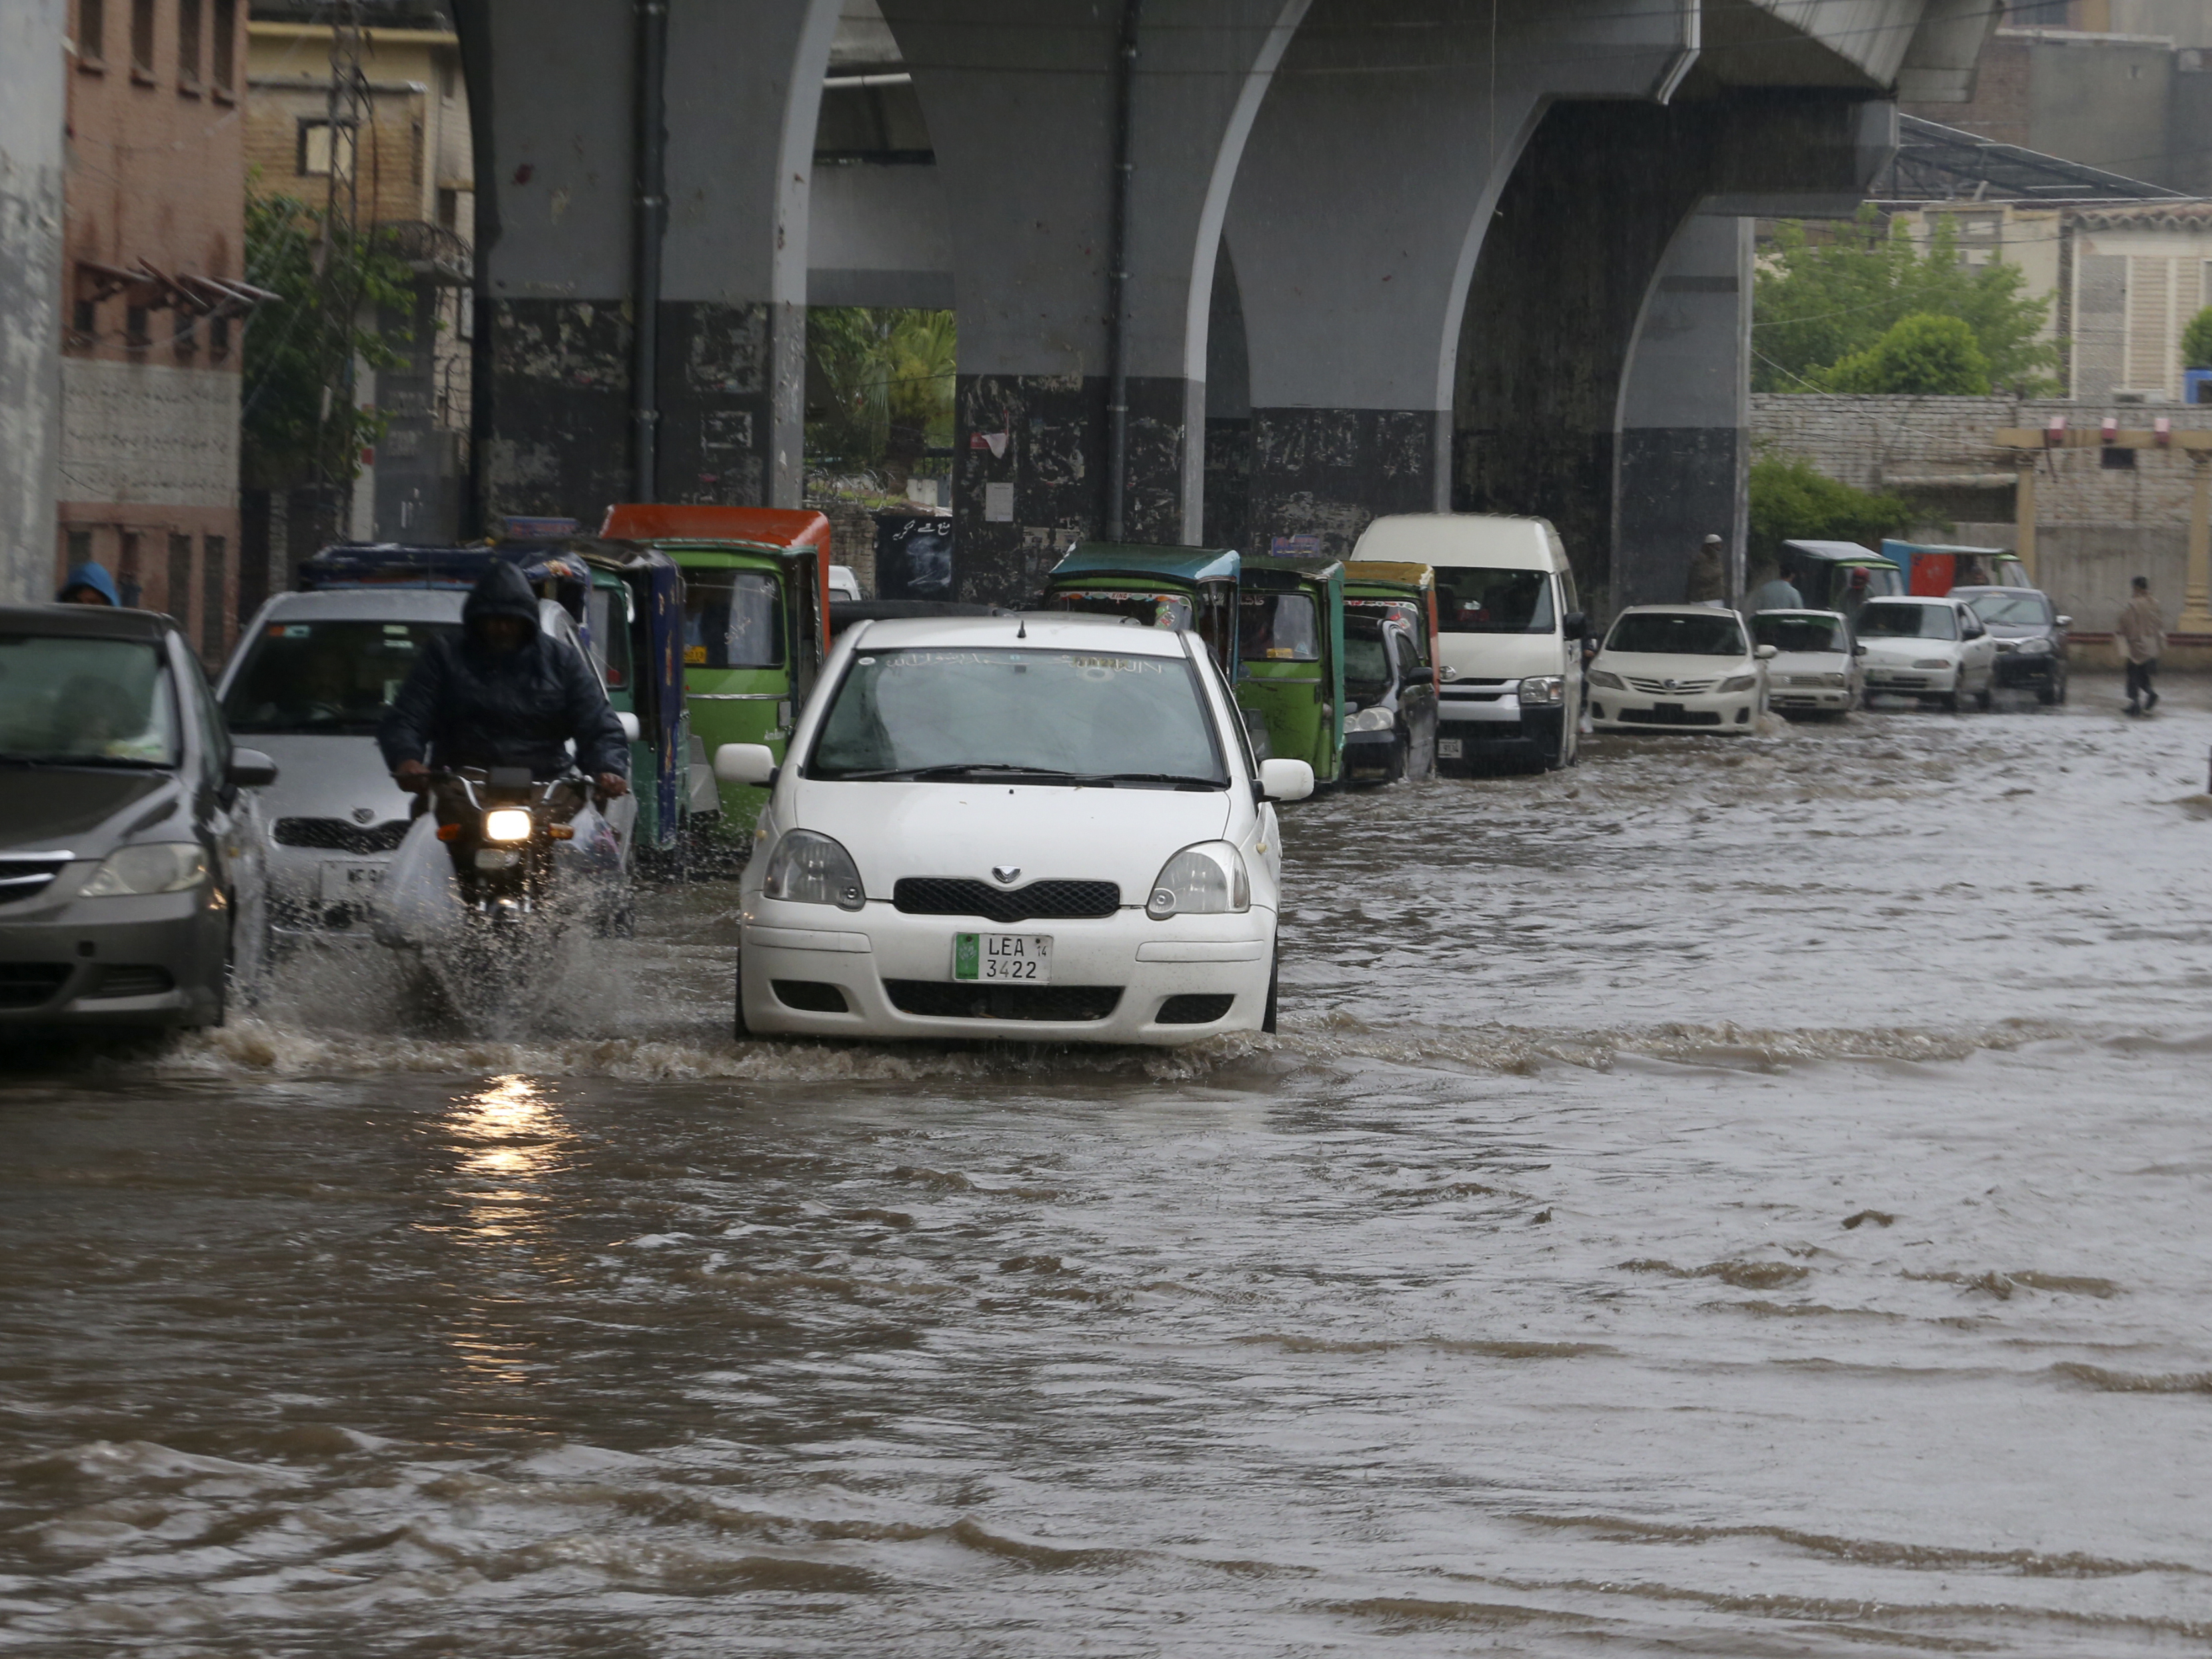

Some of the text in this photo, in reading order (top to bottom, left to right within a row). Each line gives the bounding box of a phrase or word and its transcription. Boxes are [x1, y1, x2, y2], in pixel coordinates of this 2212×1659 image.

[988, 937, 1048, 957] LEA 14
[986, 959, 1036, 979] 3422
